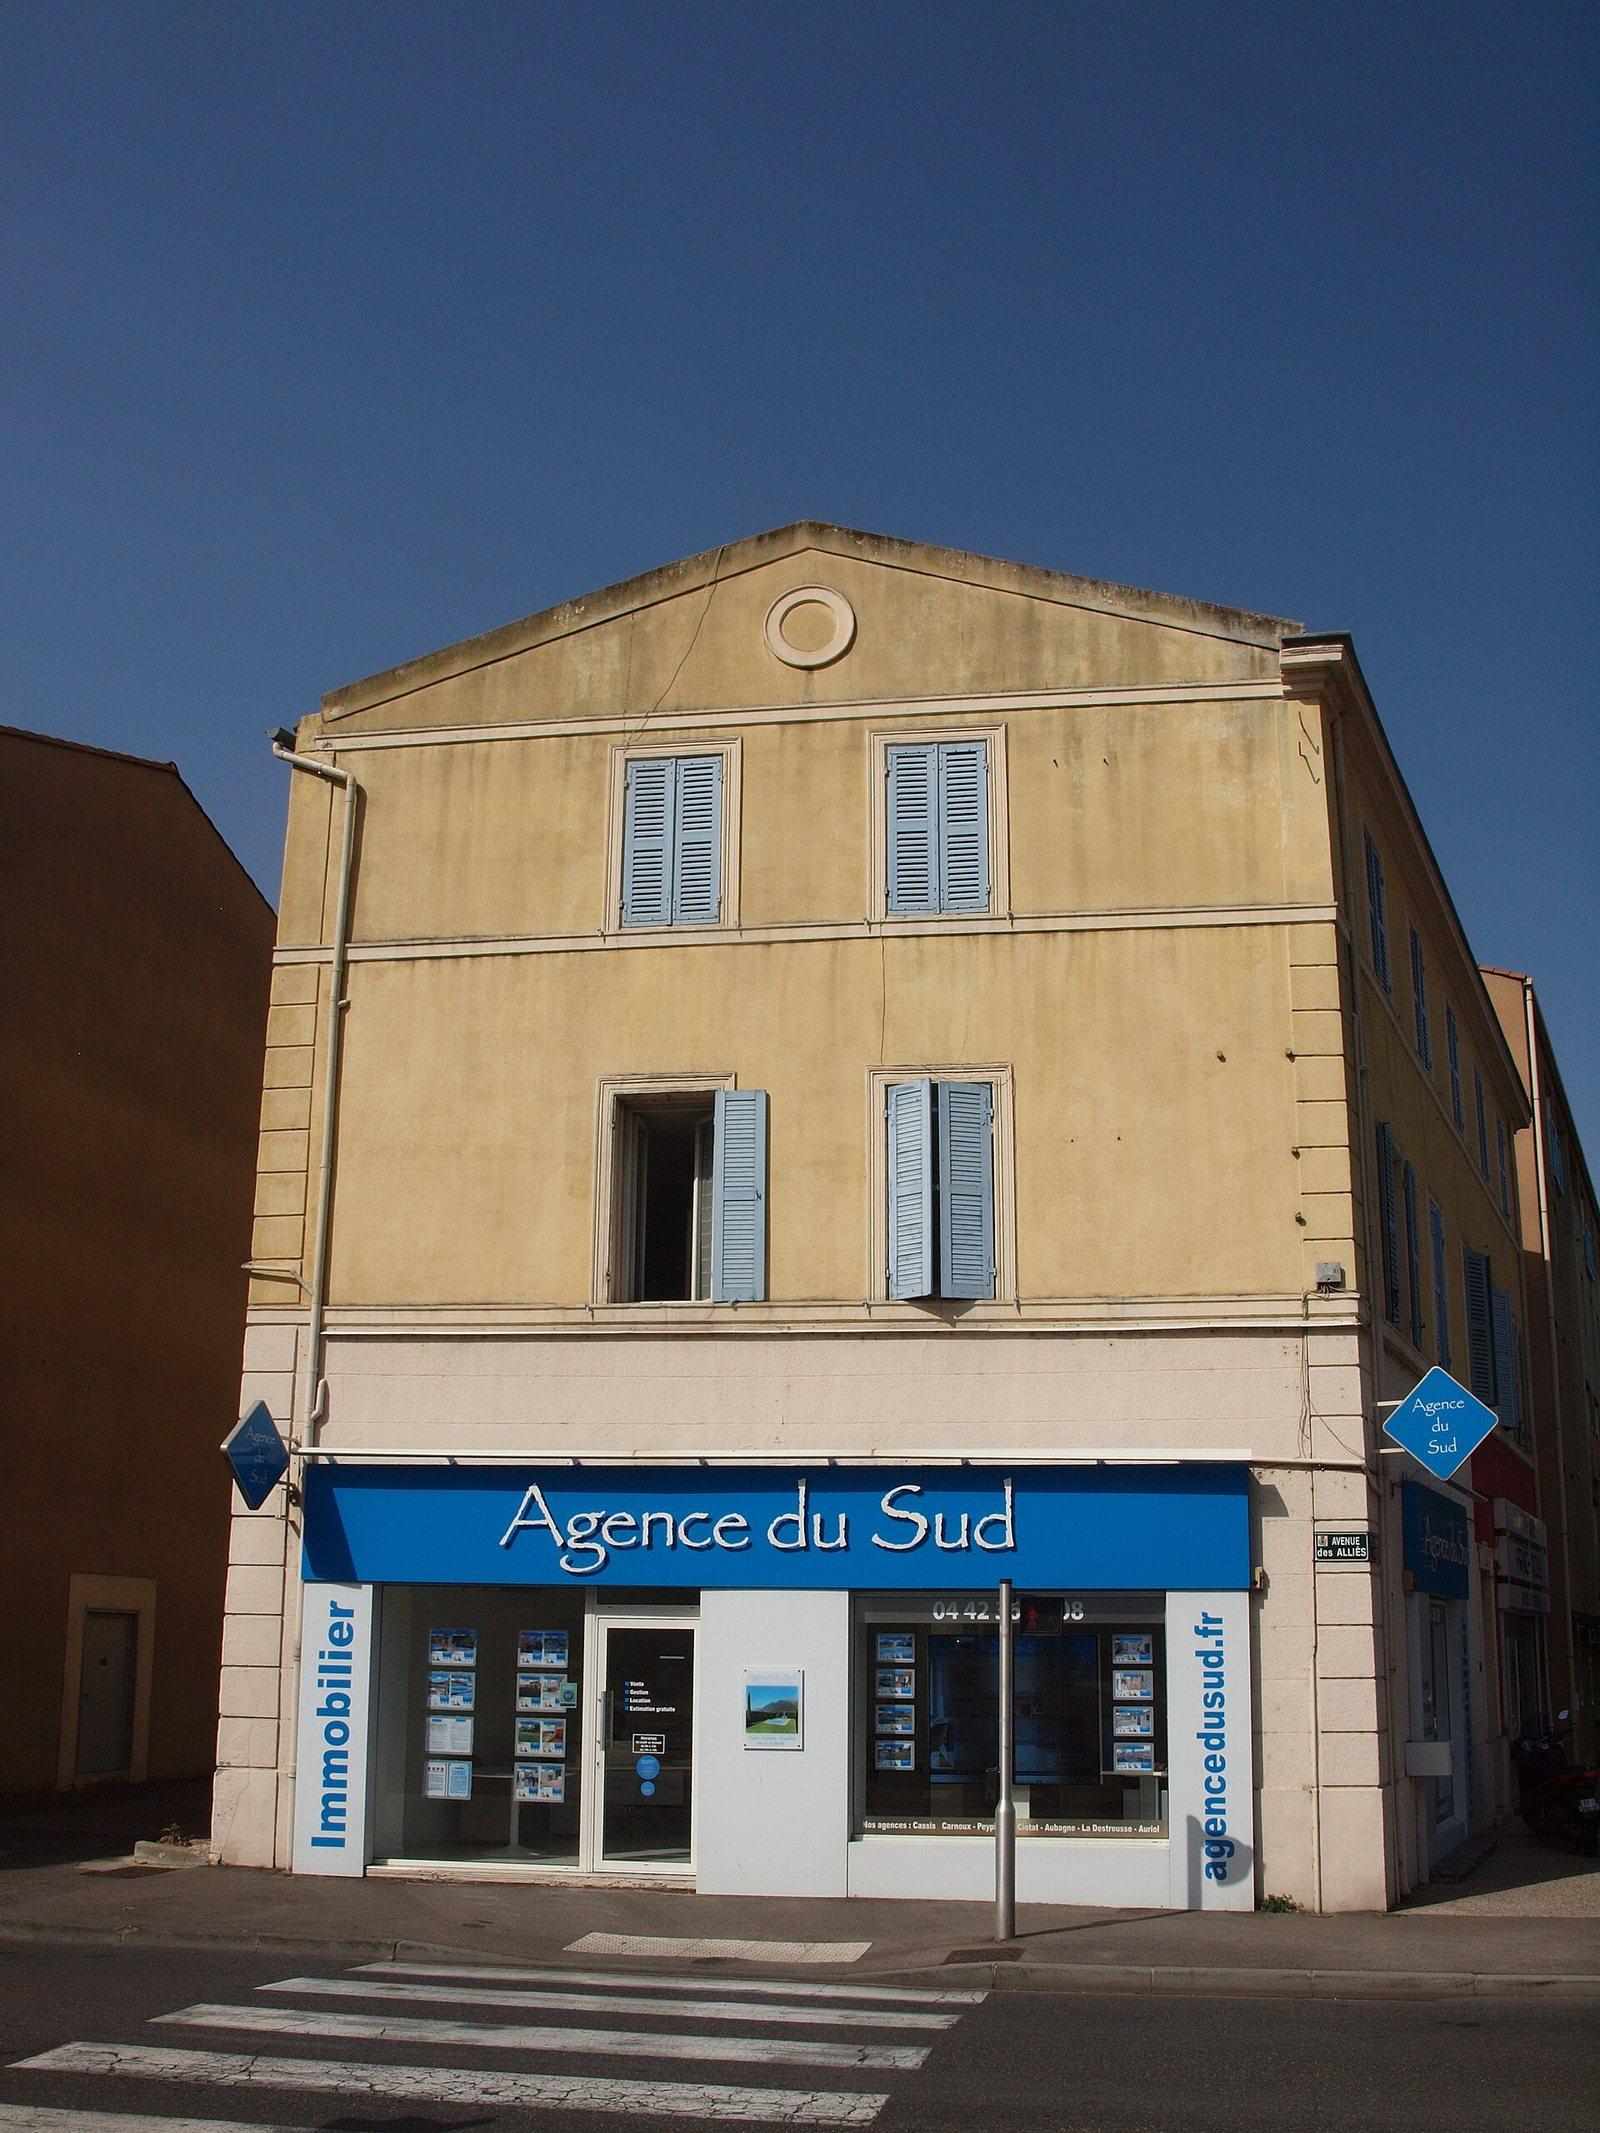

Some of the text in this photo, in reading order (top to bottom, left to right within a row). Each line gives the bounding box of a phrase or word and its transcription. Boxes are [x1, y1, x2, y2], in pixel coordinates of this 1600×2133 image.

[1412, 1398, 1465, 1417] Agence
[1431, 1417, 1449, 1433] du
[246, 1426, 276, 1446] Agence
[1427, 1437, 1457, 1454] Sud
[499, 1478, 1016, 1574] Agence du Sud
[1331, 1536, 1360, 1546] AVENUE
[1317, 1546, 1367, 1557] des ALLIÉS
[932, 1600, 959, 1620] 04
[963, 1600, 990, 1620] 42
[310, 1600, 355, 1848] Immobilier
[1194, 1611, 1235, 1881] agencedusud.fr
[862, 1820, 876, 1828] Nos
[877, 1821, 907, 1830] agences
[912, 1821, 936, 1830] Cassis
[941, 1822, 972, 1830] Carnoux
[1017, 1823, 1039, 1831] Ciotat
[1044, 1824, 1076, 1833] Aubagne
[1081, 1824, 1091, 1832] La
[1092, 1824, 1132, 1833] Destrousse
[1138, 1825, 1160, 1833] Auriol
